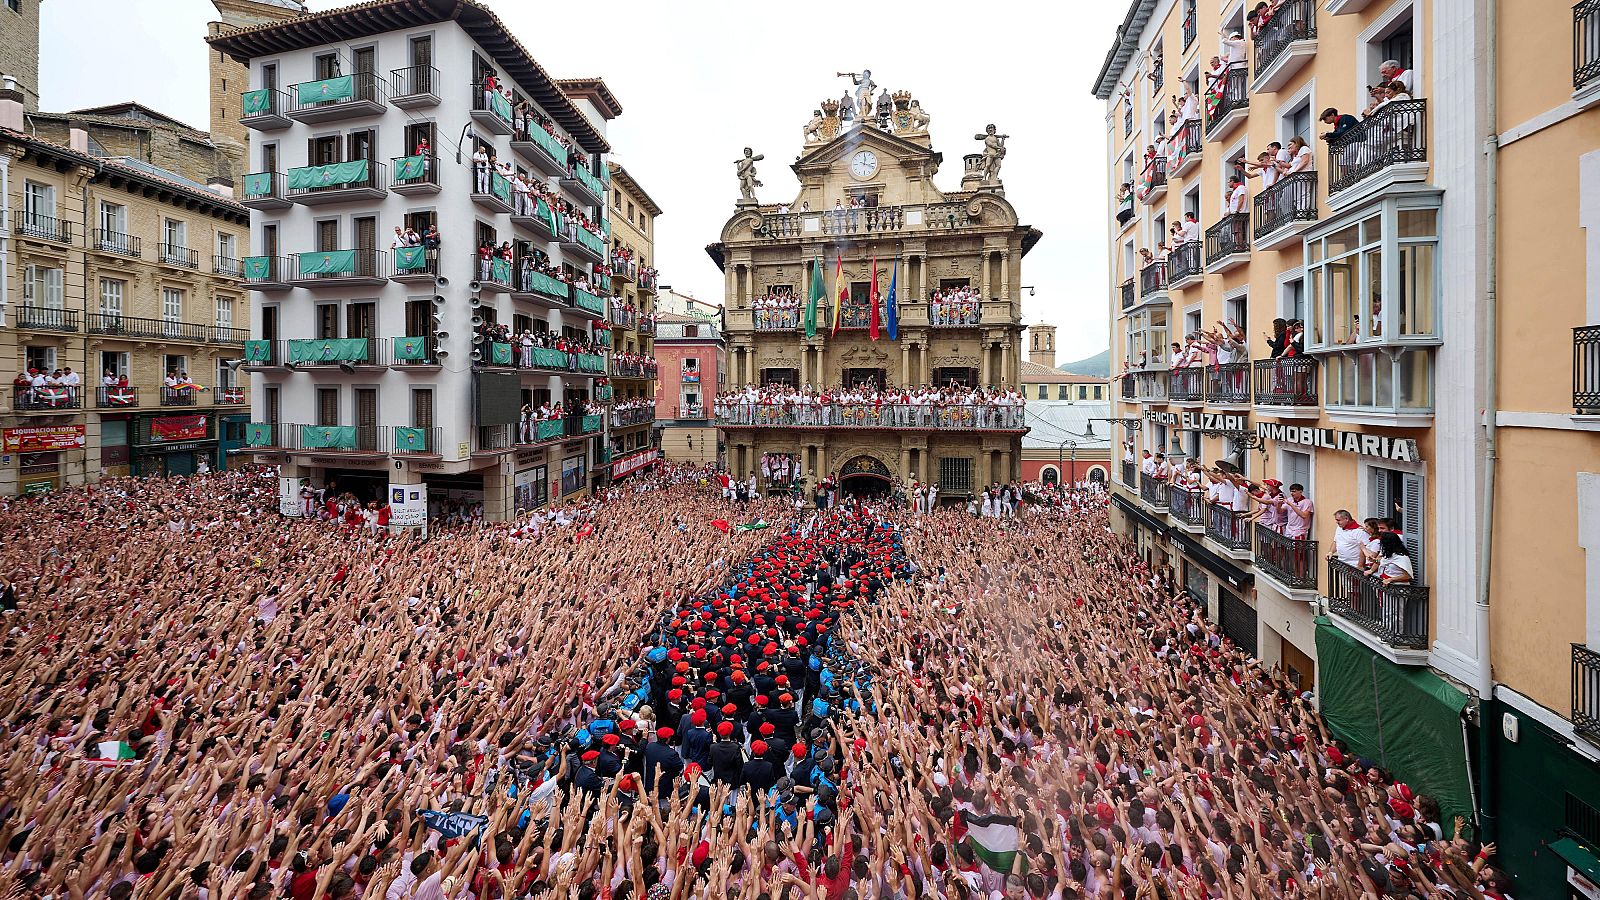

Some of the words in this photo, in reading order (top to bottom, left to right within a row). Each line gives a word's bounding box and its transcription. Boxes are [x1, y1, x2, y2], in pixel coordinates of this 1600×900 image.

[1181, 412, 1244, 431] ELIZARI
[1256, 422, 1412, 462] INMOBILIARIA
[1286, 620, 1291, 633] 2
